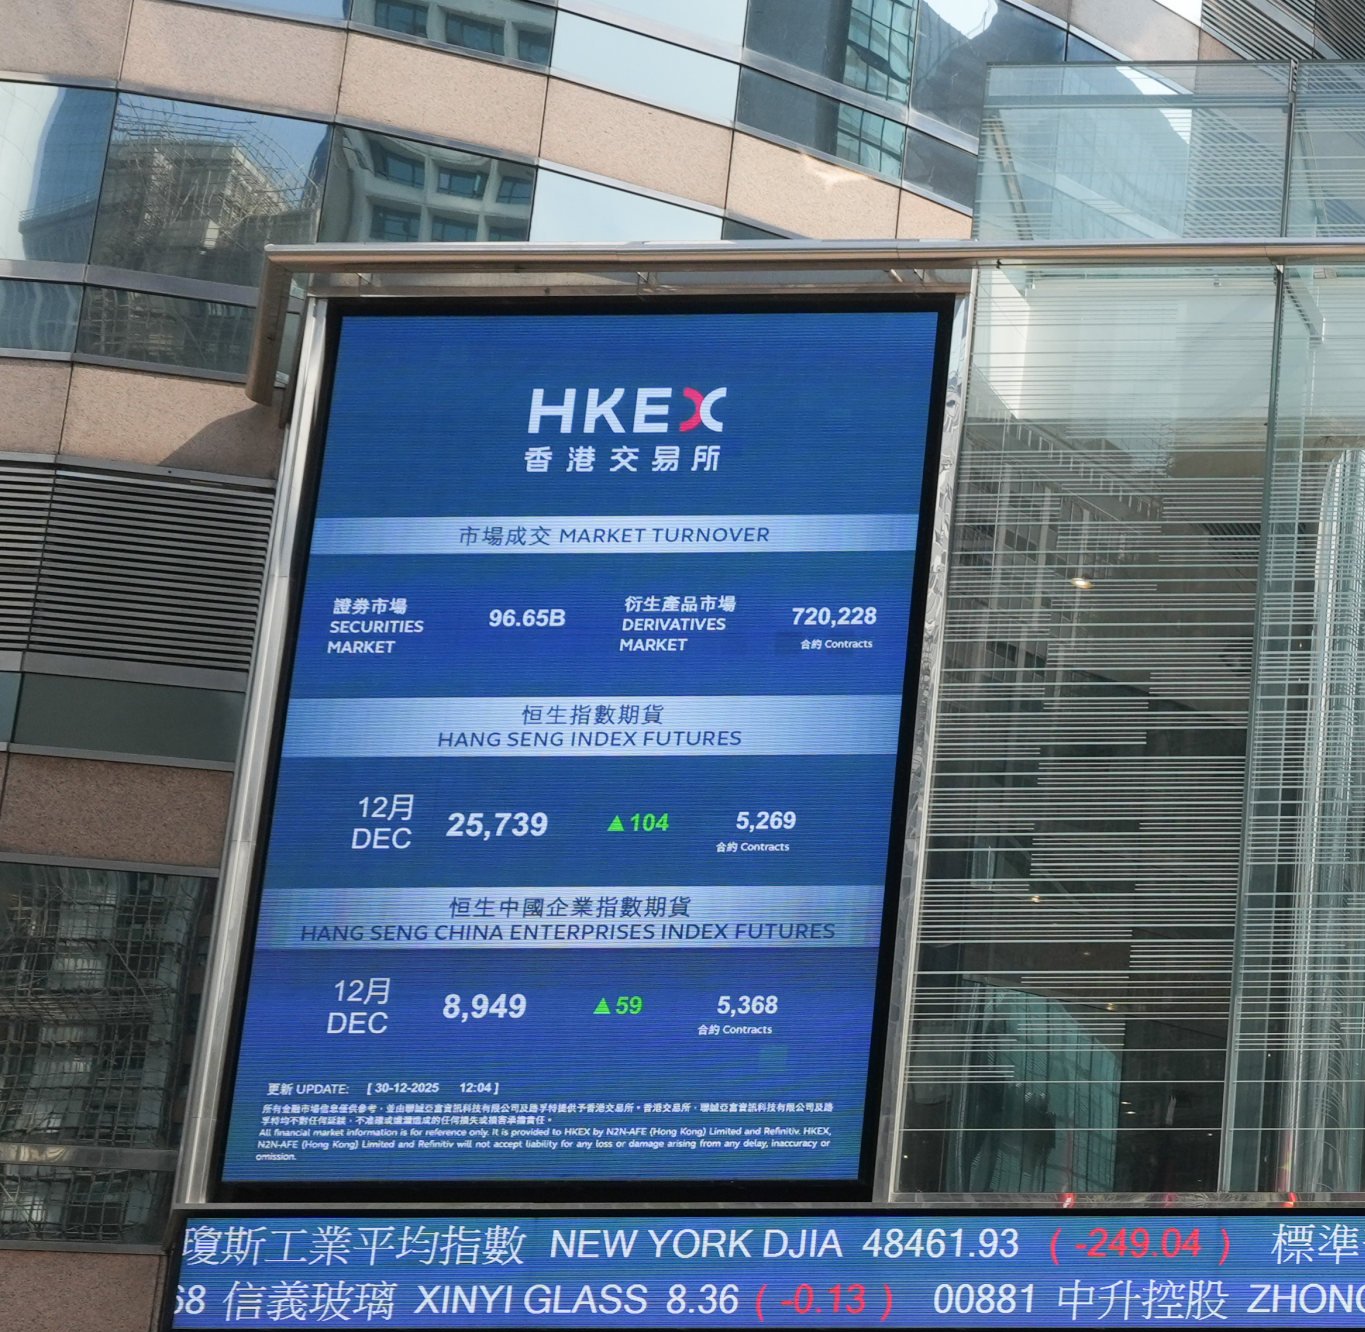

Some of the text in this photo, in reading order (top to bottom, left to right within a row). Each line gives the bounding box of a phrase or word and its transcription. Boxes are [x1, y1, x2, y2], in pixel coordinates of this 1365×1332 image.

[528, 388, 726, 433] HKEX
[525, 446, 720, 472] 香港交易所
[459, 526, 769, 546] 市場成交 MARKET TURNOVER
[625, 595, 736, 612] 衍生產品市場
[330, 621, 423, 633] SECURITIES
[490, 609, 565, 626] 96.65B
[623, 618, 725, 630] DERIVATIVES
[793, 607, 876, 627] 720,228
[328, 641, 395, 653] MARKET
[620, 639, 688, 651] MARKET
[801, 640, 872, 649] 合約 Contracts
[522, 705, 663, 725] 恒生指數期貨
[438, 731, 741, 747] HANG SENG INDEX FUTURES
[359, 794, 413, 820] 12月
[446, 812, 548, 840] 25,739
[630, 814, 669, 831] 104
[737, 811, 796, 832] 5,269
[352, 828, 411, 849] DEC
[717, 842, 789, 852] 合約 Contracts
[449, 896, 691, 919] 恒生中國企業指數期貨
[300, 921, 836, 942] HANG SENG CHINA ENTERPRISES INDEX FUTURES
[335, 978, 390, 1004] 12月
[443, 994, 526, 1022] 8,949
[617, 997, 643, 1014] 59
[718, 996, 777, 1017] 5,368
[327, 1012, 388, 1033] DEC
[698, 1025, 772, 1035] 合約 Contracts
[268, 1083, 293, 1095] 更新
[296, 1084, 348, 1094] UPDATE:
[260, 1128, 489, 1139] All financial market information is for reference only.
[182, 1225, 526, 1265] 瓊斯工業平均指數
[551, 1230, 638, 1257] NEW
[648, 1229, 753, 1258] YORK
[764, 1230, 842, 1258] DJIA
[863, 1229, 1018, 1258] 48461.93
[224, 1280, 397, 1321] 信義玻璃
[414, 1285, 512, 1313] XINYI
[524, 1284, 647, 1314] GLASS
[667, 1284, 738, 1314] 8.36
[934, 1284, 1033, 1313] 00881
[1059, 1279, 1229, 1320] 中升控股
